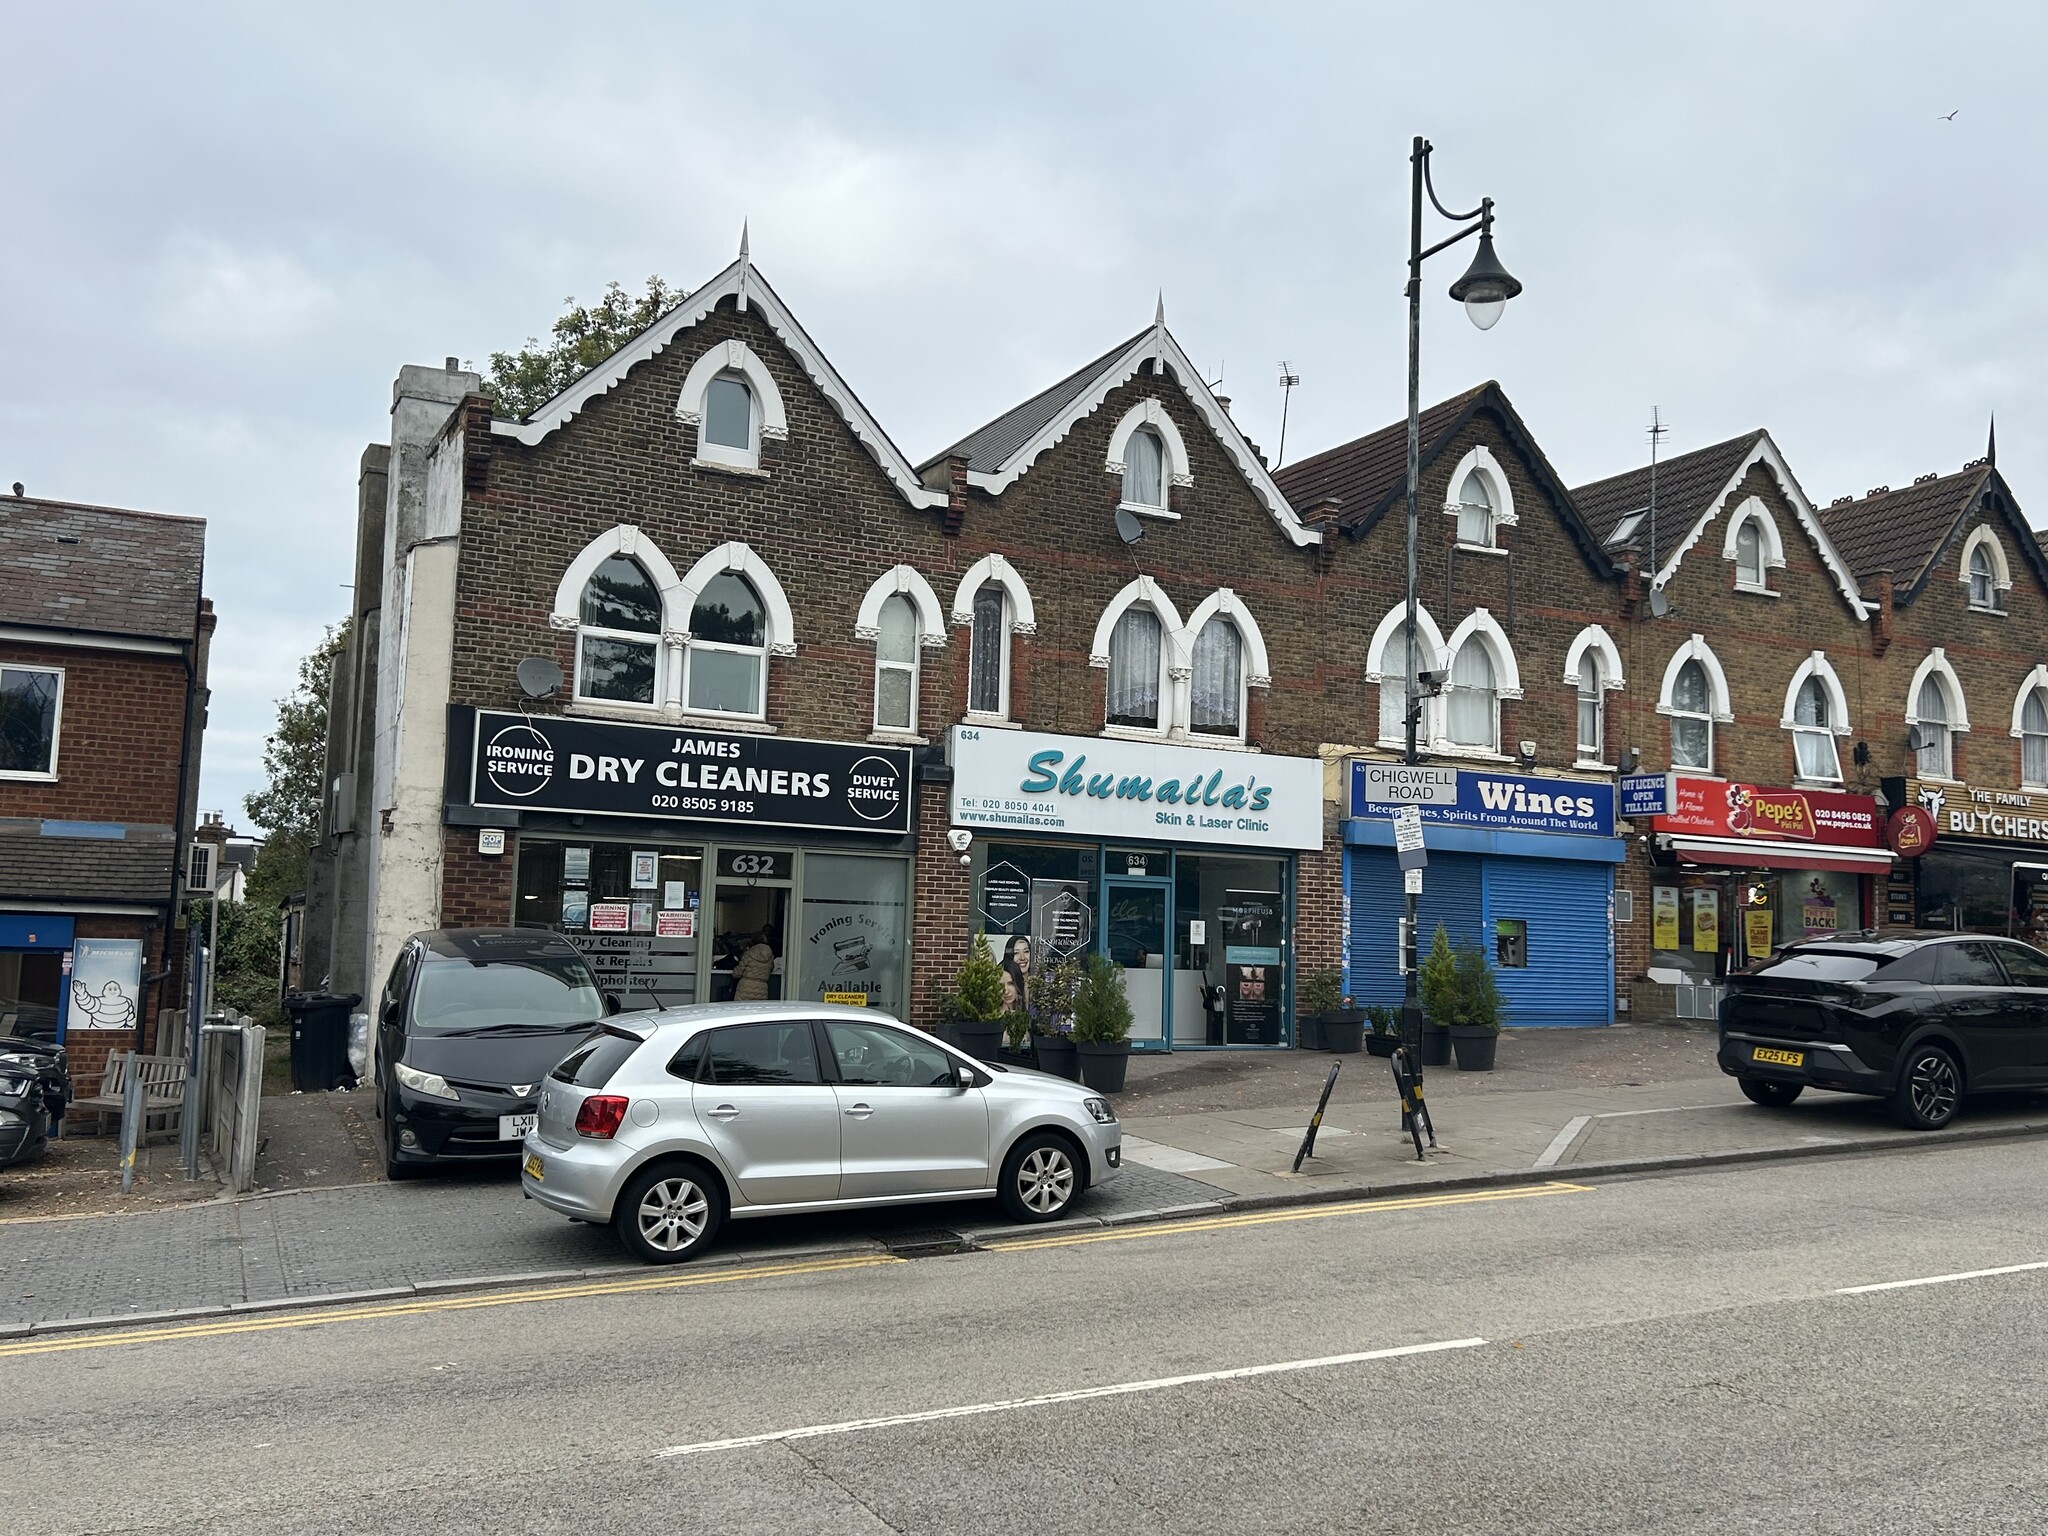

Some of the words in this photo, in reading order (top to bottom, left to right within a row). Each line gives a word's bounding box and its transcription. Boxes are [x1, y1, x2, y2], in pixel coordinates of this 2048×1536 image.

[960, 730, 980, 741] 634
[486, 745, 554, 762] IRONING
[672, 738, 740, 758] JAMES
[487, 760, 553, 776] SERVICE
[569, 753, 644, 784] DRY
[655, 761, 830, 798] CLEANERS
[853, 774, 895, 788] DUVET
[1020, 749, 1273, 811] Shumaila's
[1370, 770, 1452, 785] CHIGWELL
[1622, 779, 1635, 790] OFF
[1635, 778, 1665, 790] LICENCE
[847, 787, 900, 801] SERVICE
[1389, 786, 1434, 799] ROAD
[1478, 780, 1595, 818] Wines
[1633, 791, 1654, 801] OPEN
[1968, 786, 1991, 803] THE
[1996, 793, 2031, 807] FAMILY
[651, 795, 678, 808] 020
[682, 797, 717, 810] 8505
[721, 799, 754, 813] 9185
[961, 797, 978, 807] Tel:
[982, 799, 1000, 809] 020
[1004, 801, 1028, 811] 8050
[1032, 803, 1054, 813] 4041
[1625, 803, 1642, 813] TILL
[1643, 802, 1662, 812] LATE
[1368, 803, 1393, 813] Beer
[1419, 807, 1440, 819] nes,
[1443, 809, 1478, 822] Spirits
[1481, 812, 1507, 823] From
[1509, 815, 1547, 827] Around
[1550, 817, 1567, 828] The
[1570, 819, 1598, 830] World
[1394, 810, 1401, 819] P
[1756, 799, 1803, 824] Pepe's
[1815, 809, 1830, 818] 020
[1831, 810, 1851, 820] 8496
[1852, 812, 1871, 821] 0829
[960, 812, 1065, 827] www.shumailas.com
[1155, 812, 1181, 826] Skin
[1186, 815, 1195, 826] &
[1200, 815, 1233, 829] Laser
[1237, 818, 1269, 832] Clinic
[1781, 821, 1792, 829] Piri
[1816, 818, 1872, 830] www.pepes.co.uk
[1950, 804, 2048, 840] BUTCHERS
[483, 835, 501, 843] COP
[732, 854, 774, 874] 632
[1128, 855, 1146, 866] 634
[1805, 917, 1835, 928] BACK!
[809, 915, 853, 945] Ironing
[573, 937, 595, 949] Dry
[595, 956, 605, 967] &
[817, 980, 882, 993] Available
[1757, 1049, 1779, 1061] EX25
[1780, 1052, 1799, 1064] LFS
[513, 1116, 534, 1127] LX11
